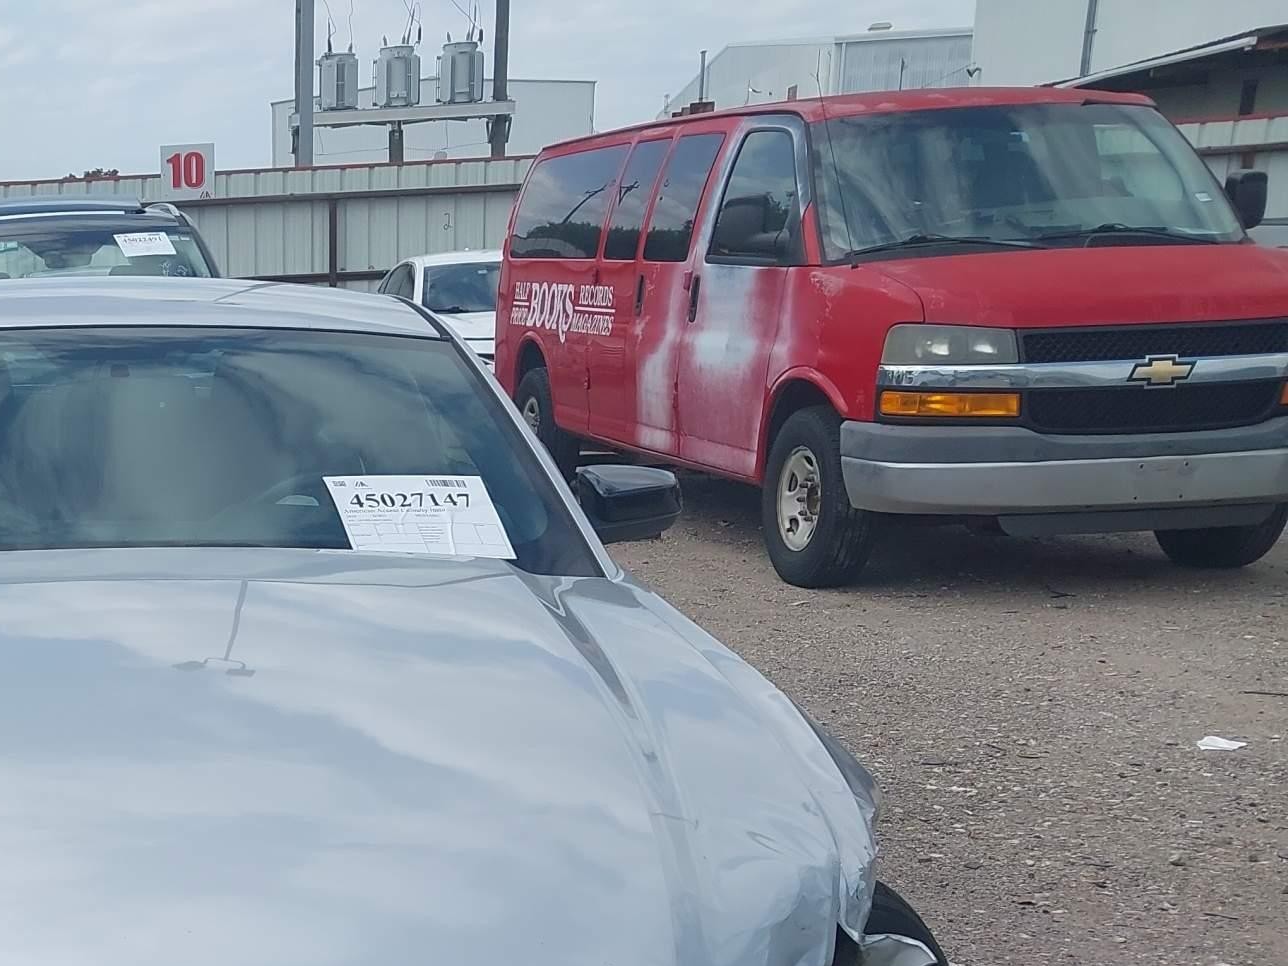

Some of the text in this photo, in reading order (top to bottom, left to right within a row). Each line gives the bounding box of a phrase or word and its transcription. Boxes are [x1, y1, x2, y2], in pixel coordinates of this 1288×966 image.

[166, 151, 206, 190] 10
[514, 281, 531, 300] HALF
[579, 285, 614, 307] RECORDS
[510, 307, 529, 326] PRICE
[526, 281, 575, 344] BOOKS
[570, 312, 614, 336] MAGAZINES
[350, 492, 470, 508] 45027147
